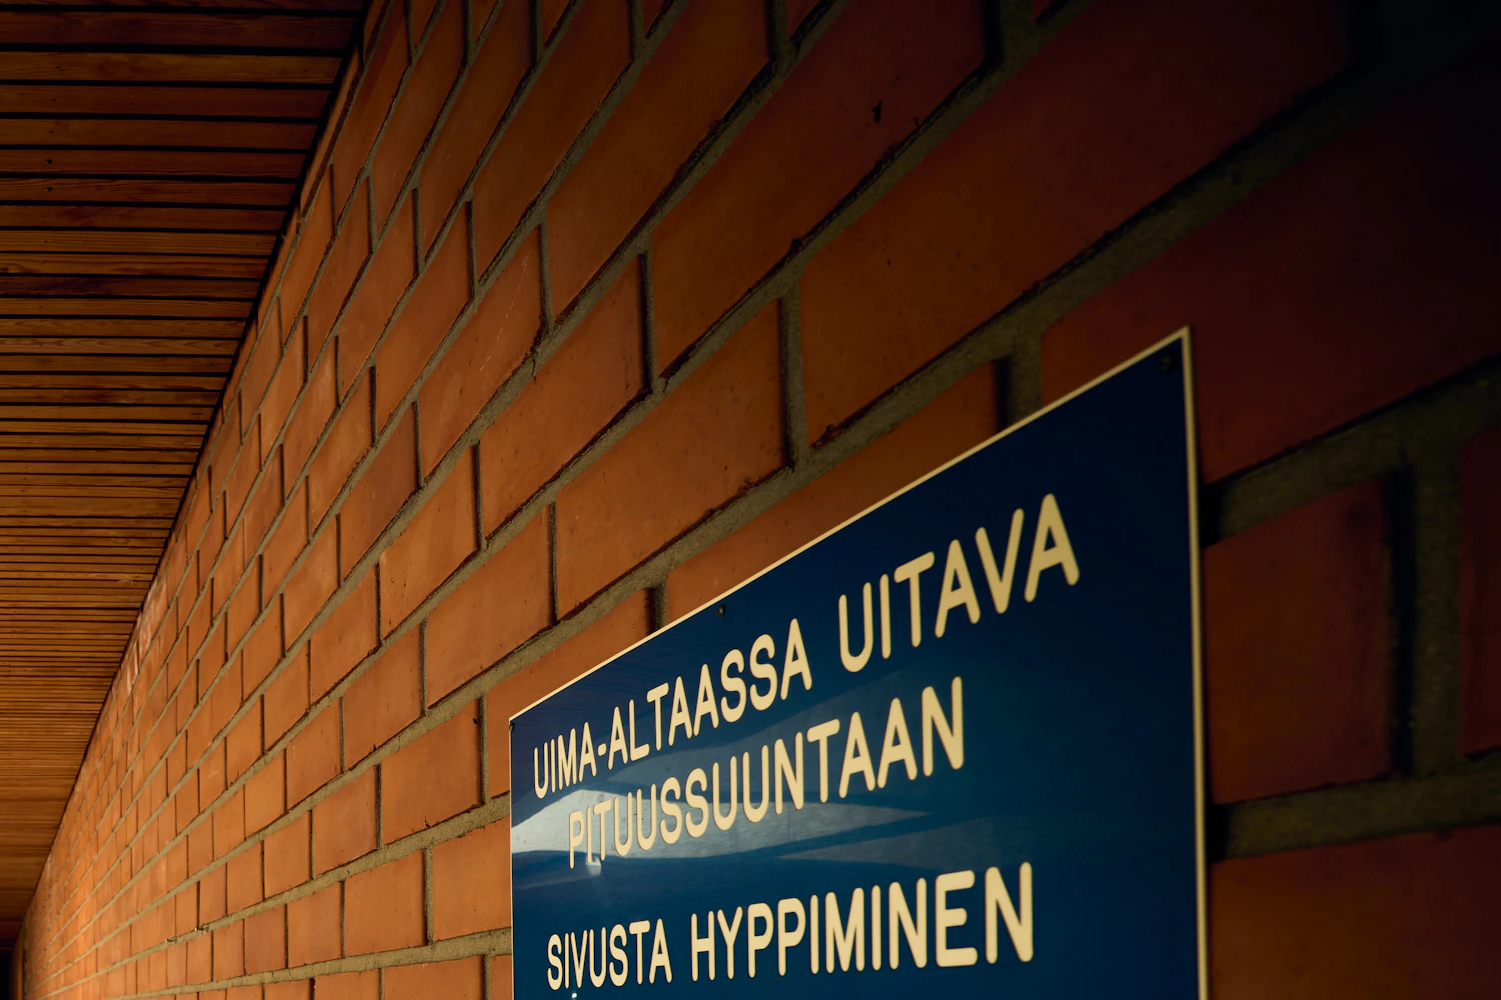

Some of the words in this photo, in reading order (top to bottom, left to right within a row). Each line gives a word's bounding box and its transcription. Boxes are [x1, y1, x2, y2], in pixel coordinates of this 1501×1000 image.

[534, 618, 812, 799] UIMA-ALTAASSA
[838, 493, 1080, 673] UITAVA
[569, 676, 964, 869] PITUUSSUUNTAAN
[547, 918, 673, 990] SIVUSTA
[691, 861, 1034, 981] HYPPIMINEN
